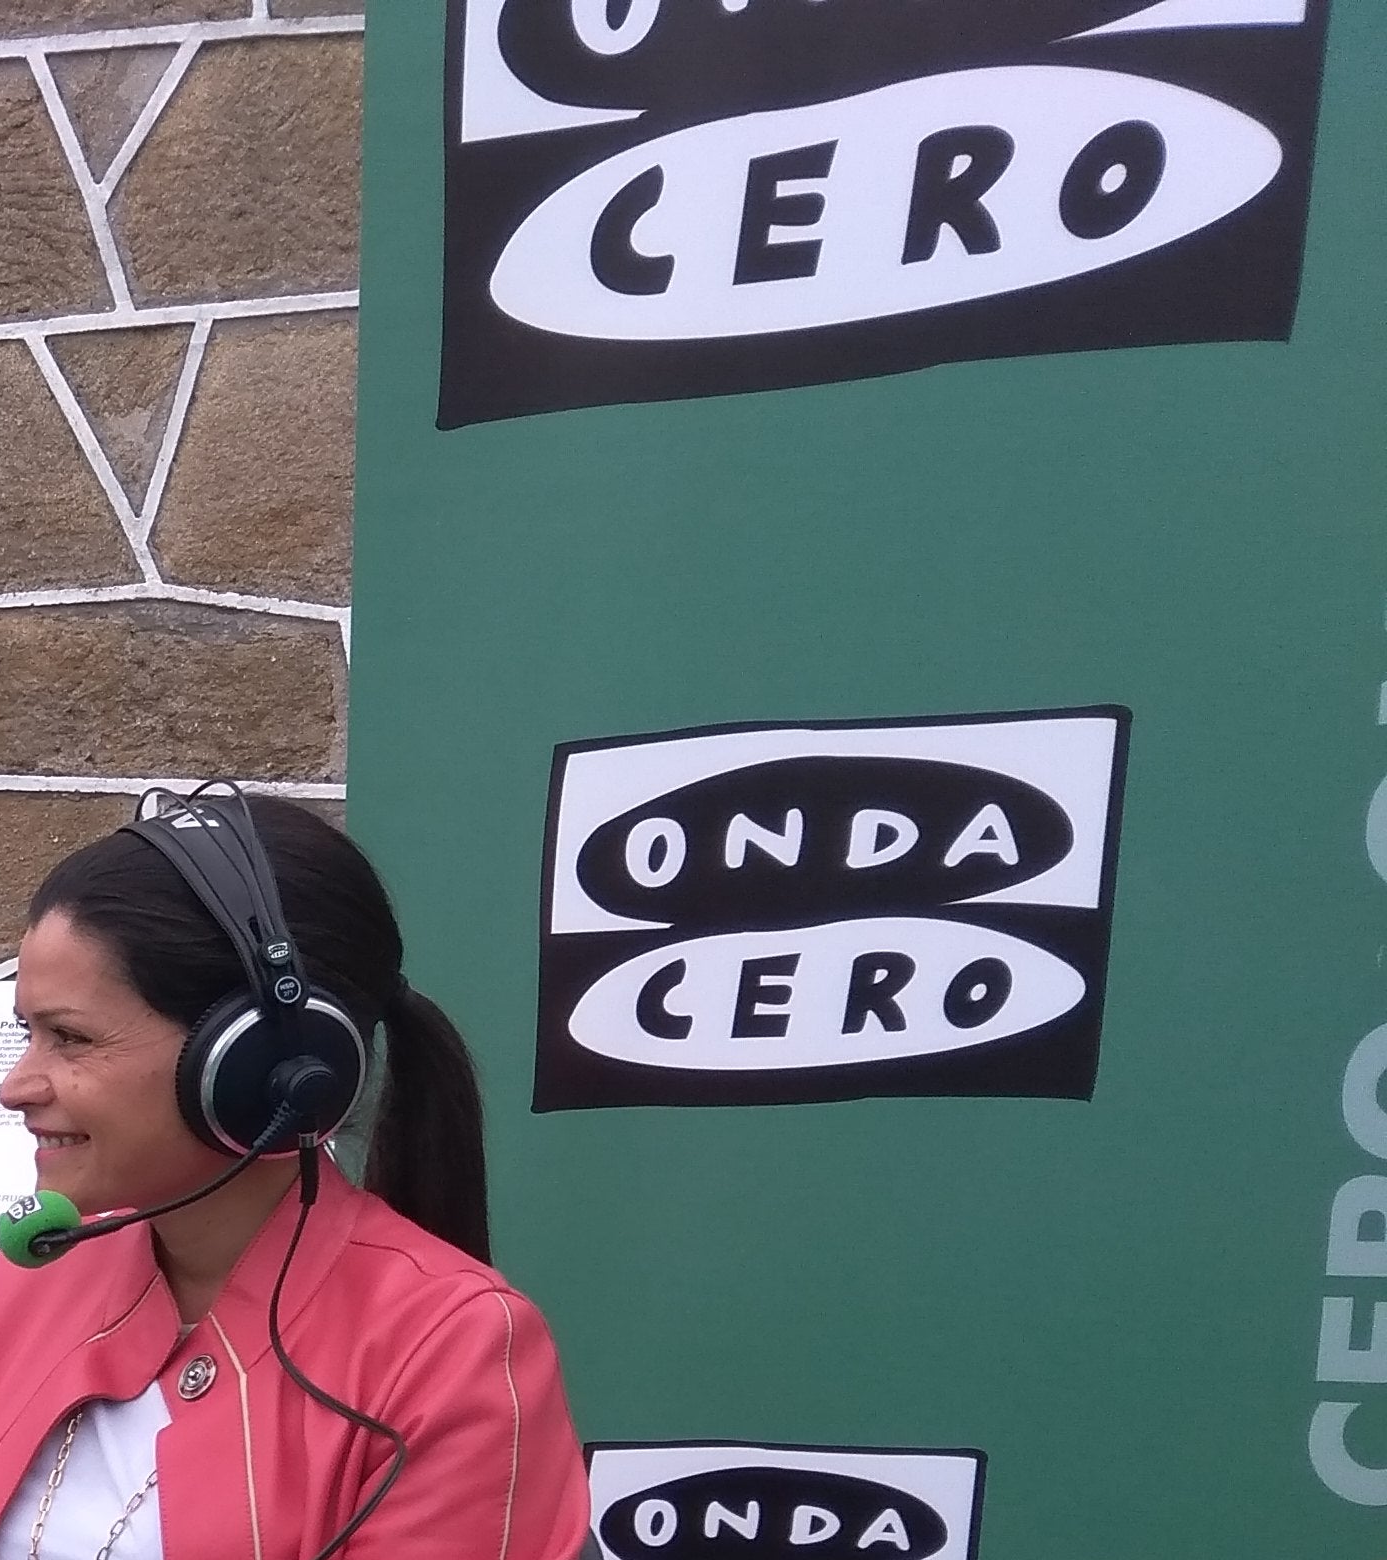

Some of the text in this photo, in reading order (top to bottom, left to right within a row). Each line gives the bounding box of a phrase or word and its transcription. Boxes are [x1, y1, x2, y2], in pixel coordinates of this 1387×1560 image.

[590, 120, 1166, 297] CERO
[623, 803, 1021, 889] ONDA
[636, 950, 1013, 1040] CERO
[633, 1498, 913, 1552] ONDA
